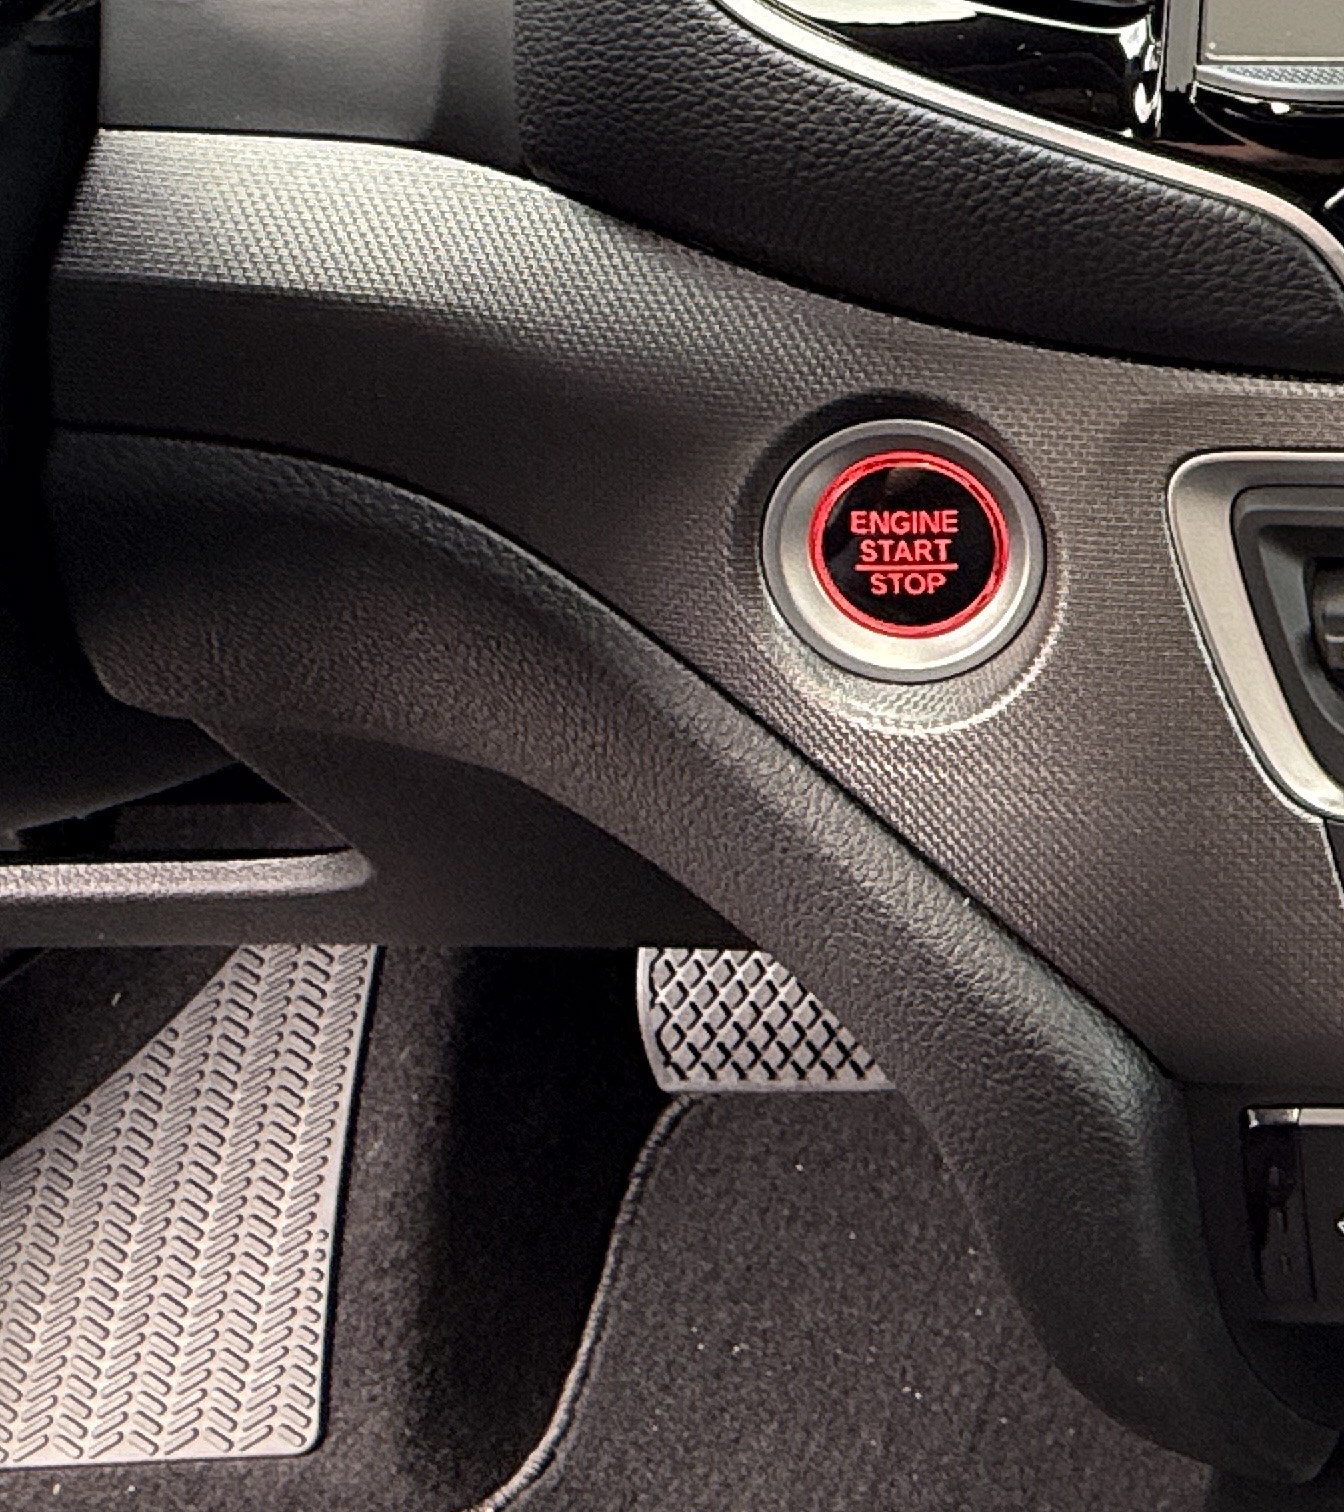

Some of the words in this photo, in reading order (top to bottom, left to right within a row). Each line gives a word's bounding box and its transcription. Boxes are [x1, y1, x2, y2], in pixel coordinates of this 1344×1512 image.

[850, 509, 959, 534] ENGINE
[860, 538, 952, 562] START
[870, 572, 947, 595] STOP
